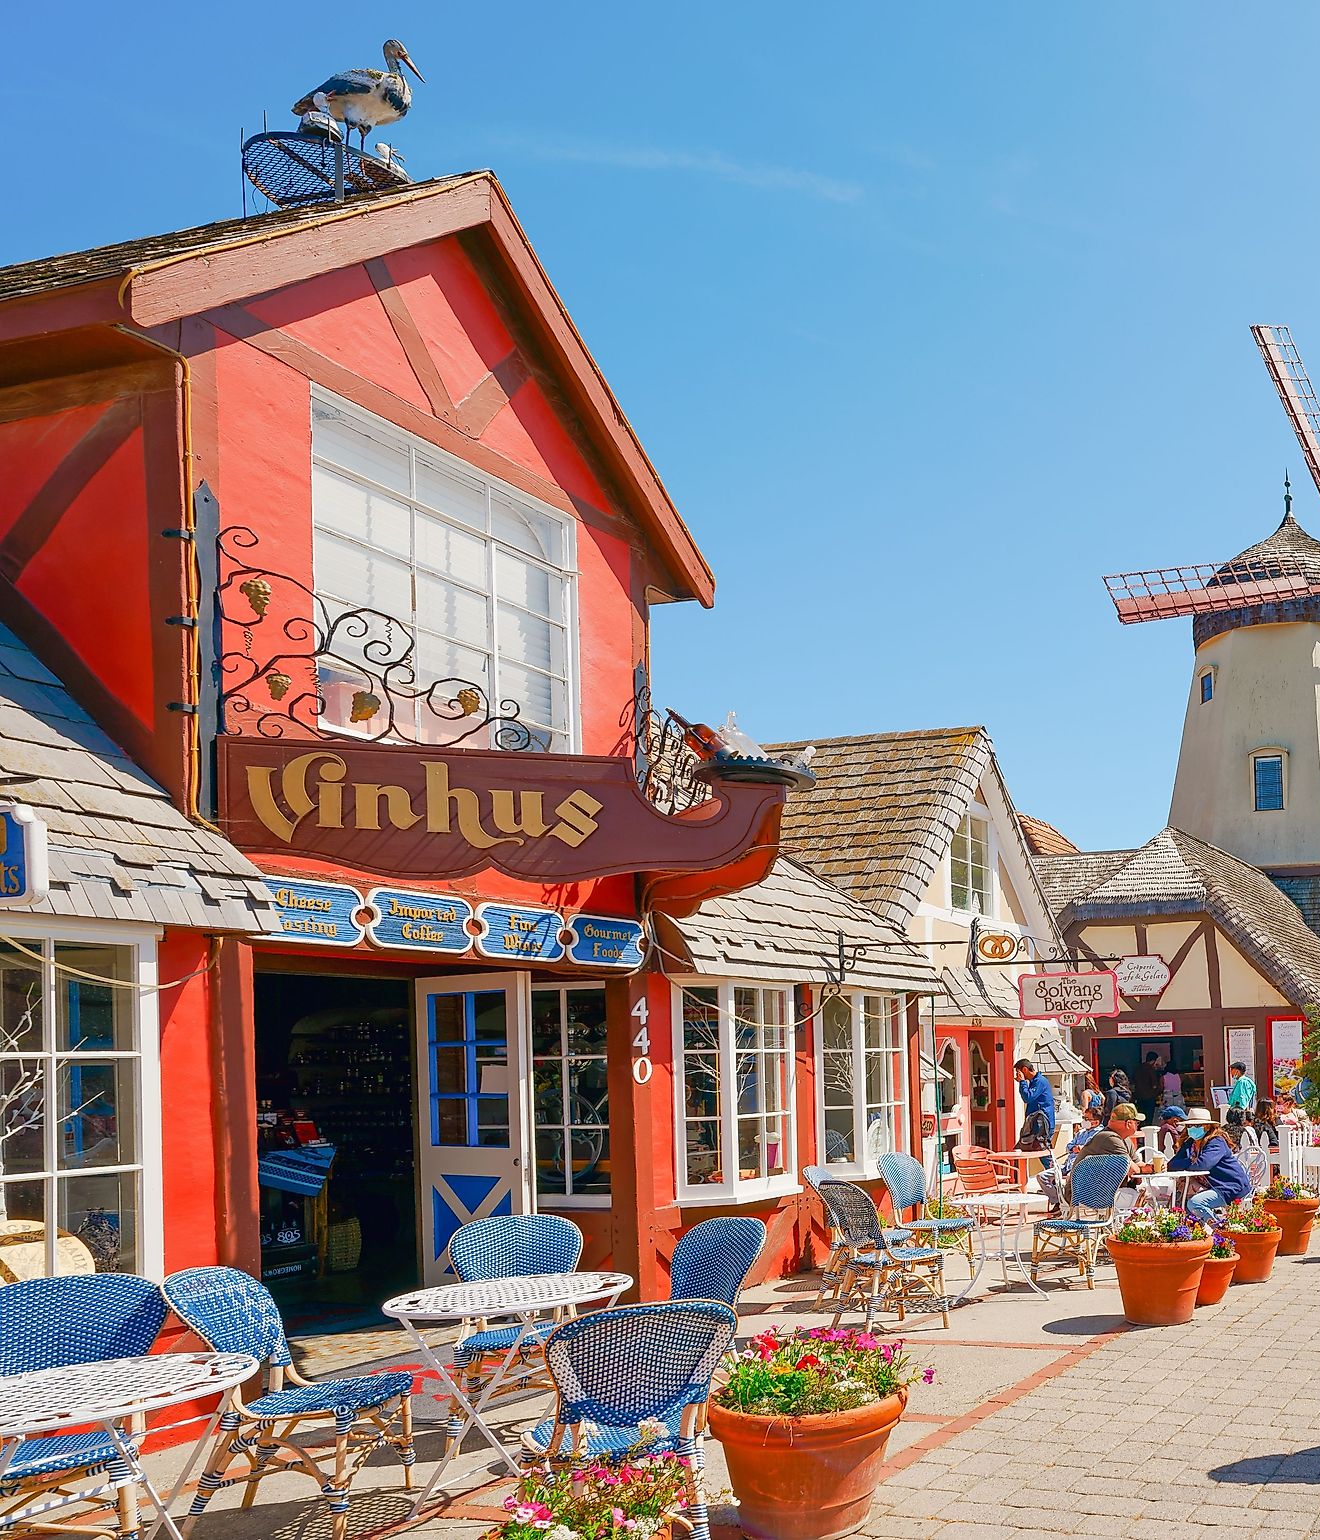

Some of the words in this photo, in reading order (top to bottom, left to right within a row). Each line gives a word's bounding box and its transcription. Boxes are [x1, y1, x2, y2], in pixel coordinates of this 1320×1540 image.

[246, 752, 603, 848] Vinhus
[275, 888, 332, 912] Cheese
[388, 899, 456, 922] Imported
[276, 912, 337, 938] asting
[402, 922, 444, 942] Coffee
[509, 914, 538, 932] Fine
[584, 924, 632, 942] Gourmet
[503, 934, 543, 953] Wines
[593, 942, 623, 960] Foods
[1061, 976, 1077, 985] The
[1141, 970, 1167, 981] Gelato
[1035, 980, 1103, 1000] Solvang
[1044, 996, 1095, 1012] Bakery
[630, 996, 653, 1084] 440
[277, 1230, 301, 1243] 805
